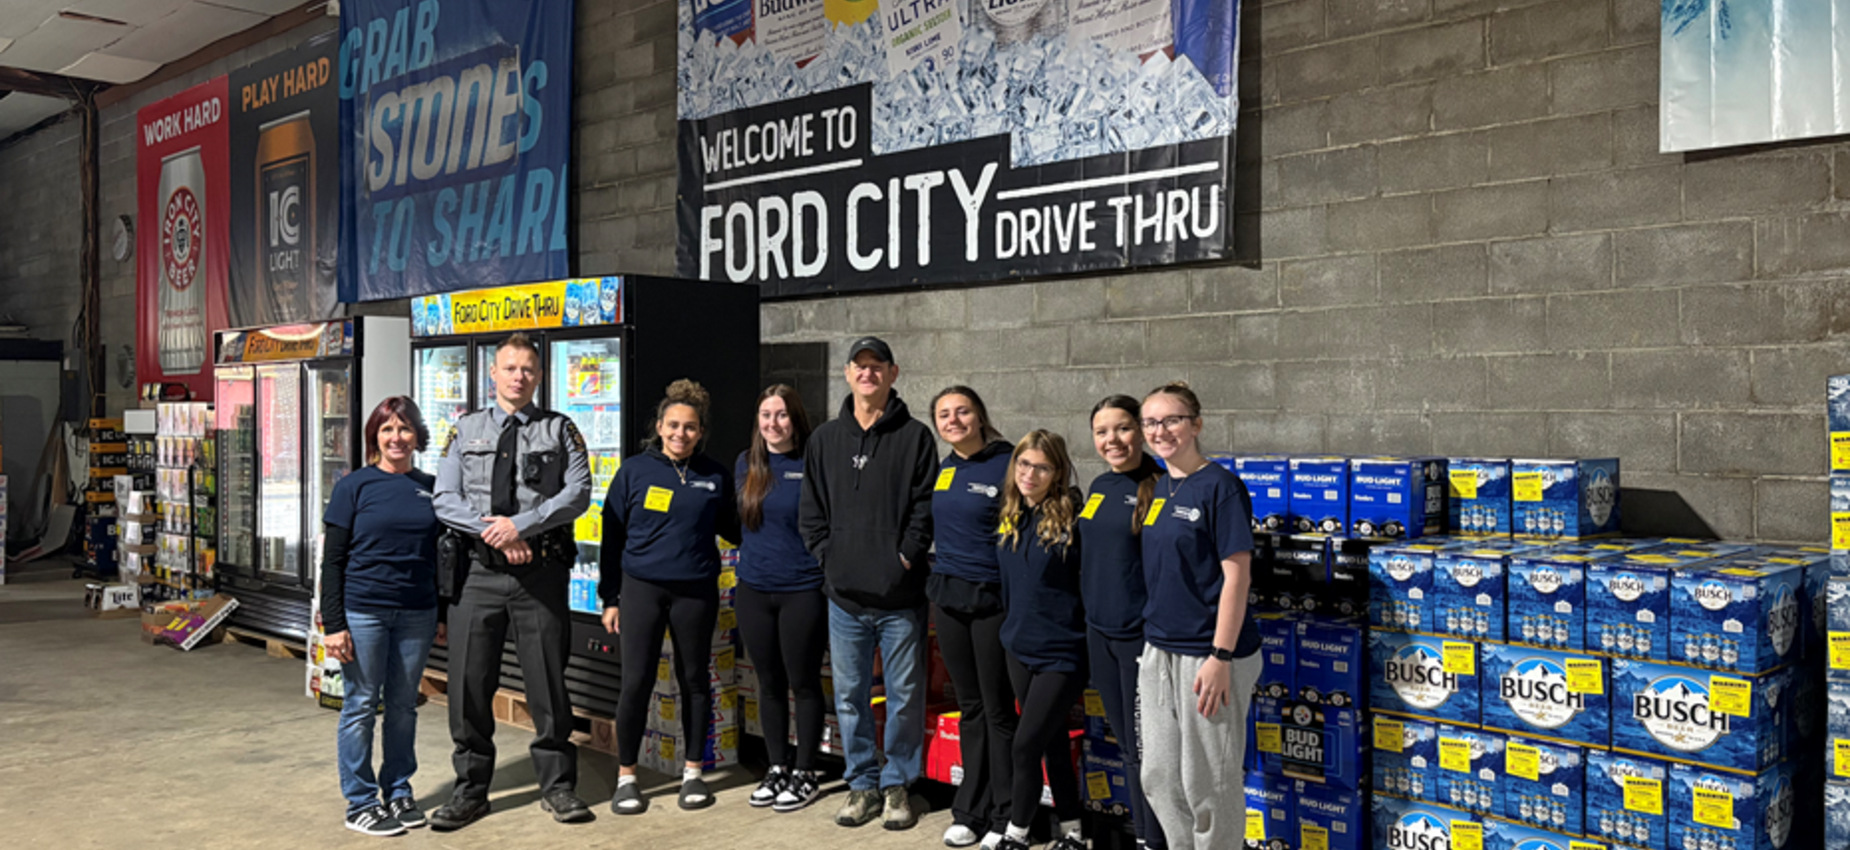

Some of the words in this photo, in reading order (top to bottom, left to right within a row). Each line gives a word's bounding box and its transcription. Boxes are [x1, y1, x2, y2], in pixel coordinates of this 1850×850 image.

[339, 0, 440, 99] GRAB
[942, 45, 954, 61] 90
[242, 75, 280, 112] PLAY
[283, 57, 330, 98] HARD
[144, 111, 182, 147] WORK
[184, 97, 221, 133] HARD
[700, 119, 814, 175] WELCOME
[821, 105, 856, 149] TO
[164, 192, 183, 245] IRON
[184, 195, 200, 238] CITY
[269, 185, 300, 247] IC
[700, 190, 828, 284] FORD
[846, 162, 999, 272] CITY
[997, 199, 1097, 260] DRIVE
[1107, 184, 1220, 249] THRU
[368, 196, 415, 275] TO
[270, 250, 300, 272] LIGHT
[169, 259, 196, 289] BEER
[455, 302, 479, 324] FORD
[480, 299, 502, 321] CITY
[504, 296, 531, 320] DRIVE
[532, 293, 560, 317] THRU
[1294, 474, 1311, 482] BUD
[1313, 475, 1337, 483] LIGHT
[1356, 476, 1374, 484] BUD
[1375, 477, 1402, 486] LIGHT
[1293, 552, 1319, 562] LIGHT
[1387, 562, 1415, 572] BUSCH
[1453, 567, 1483, 578] BUSCH
[1530, 573, 1562, 584] BUSCH
[1609, 580, 1644, 592] BUSCH
[1695, 587, 1732, 600] BUSCH
[113, 592, 134, 605] Lite
[1301, 639, 1320, 650] BUD
[1321, 642, 1348, 654] LIGHT
[1386, 661, 1456, 690] BUSCH
[1501, 677, 1582, 708] BUSCH
[1635, 695, 1727, 730] BUSCH
[1285, 728, 1319, 746] BUD
[1282, 742, 1324, 762] LIGHT
[1319, 802, 1346, 814] LIGHT
[1390, 827, 1451, 850] BUSC
